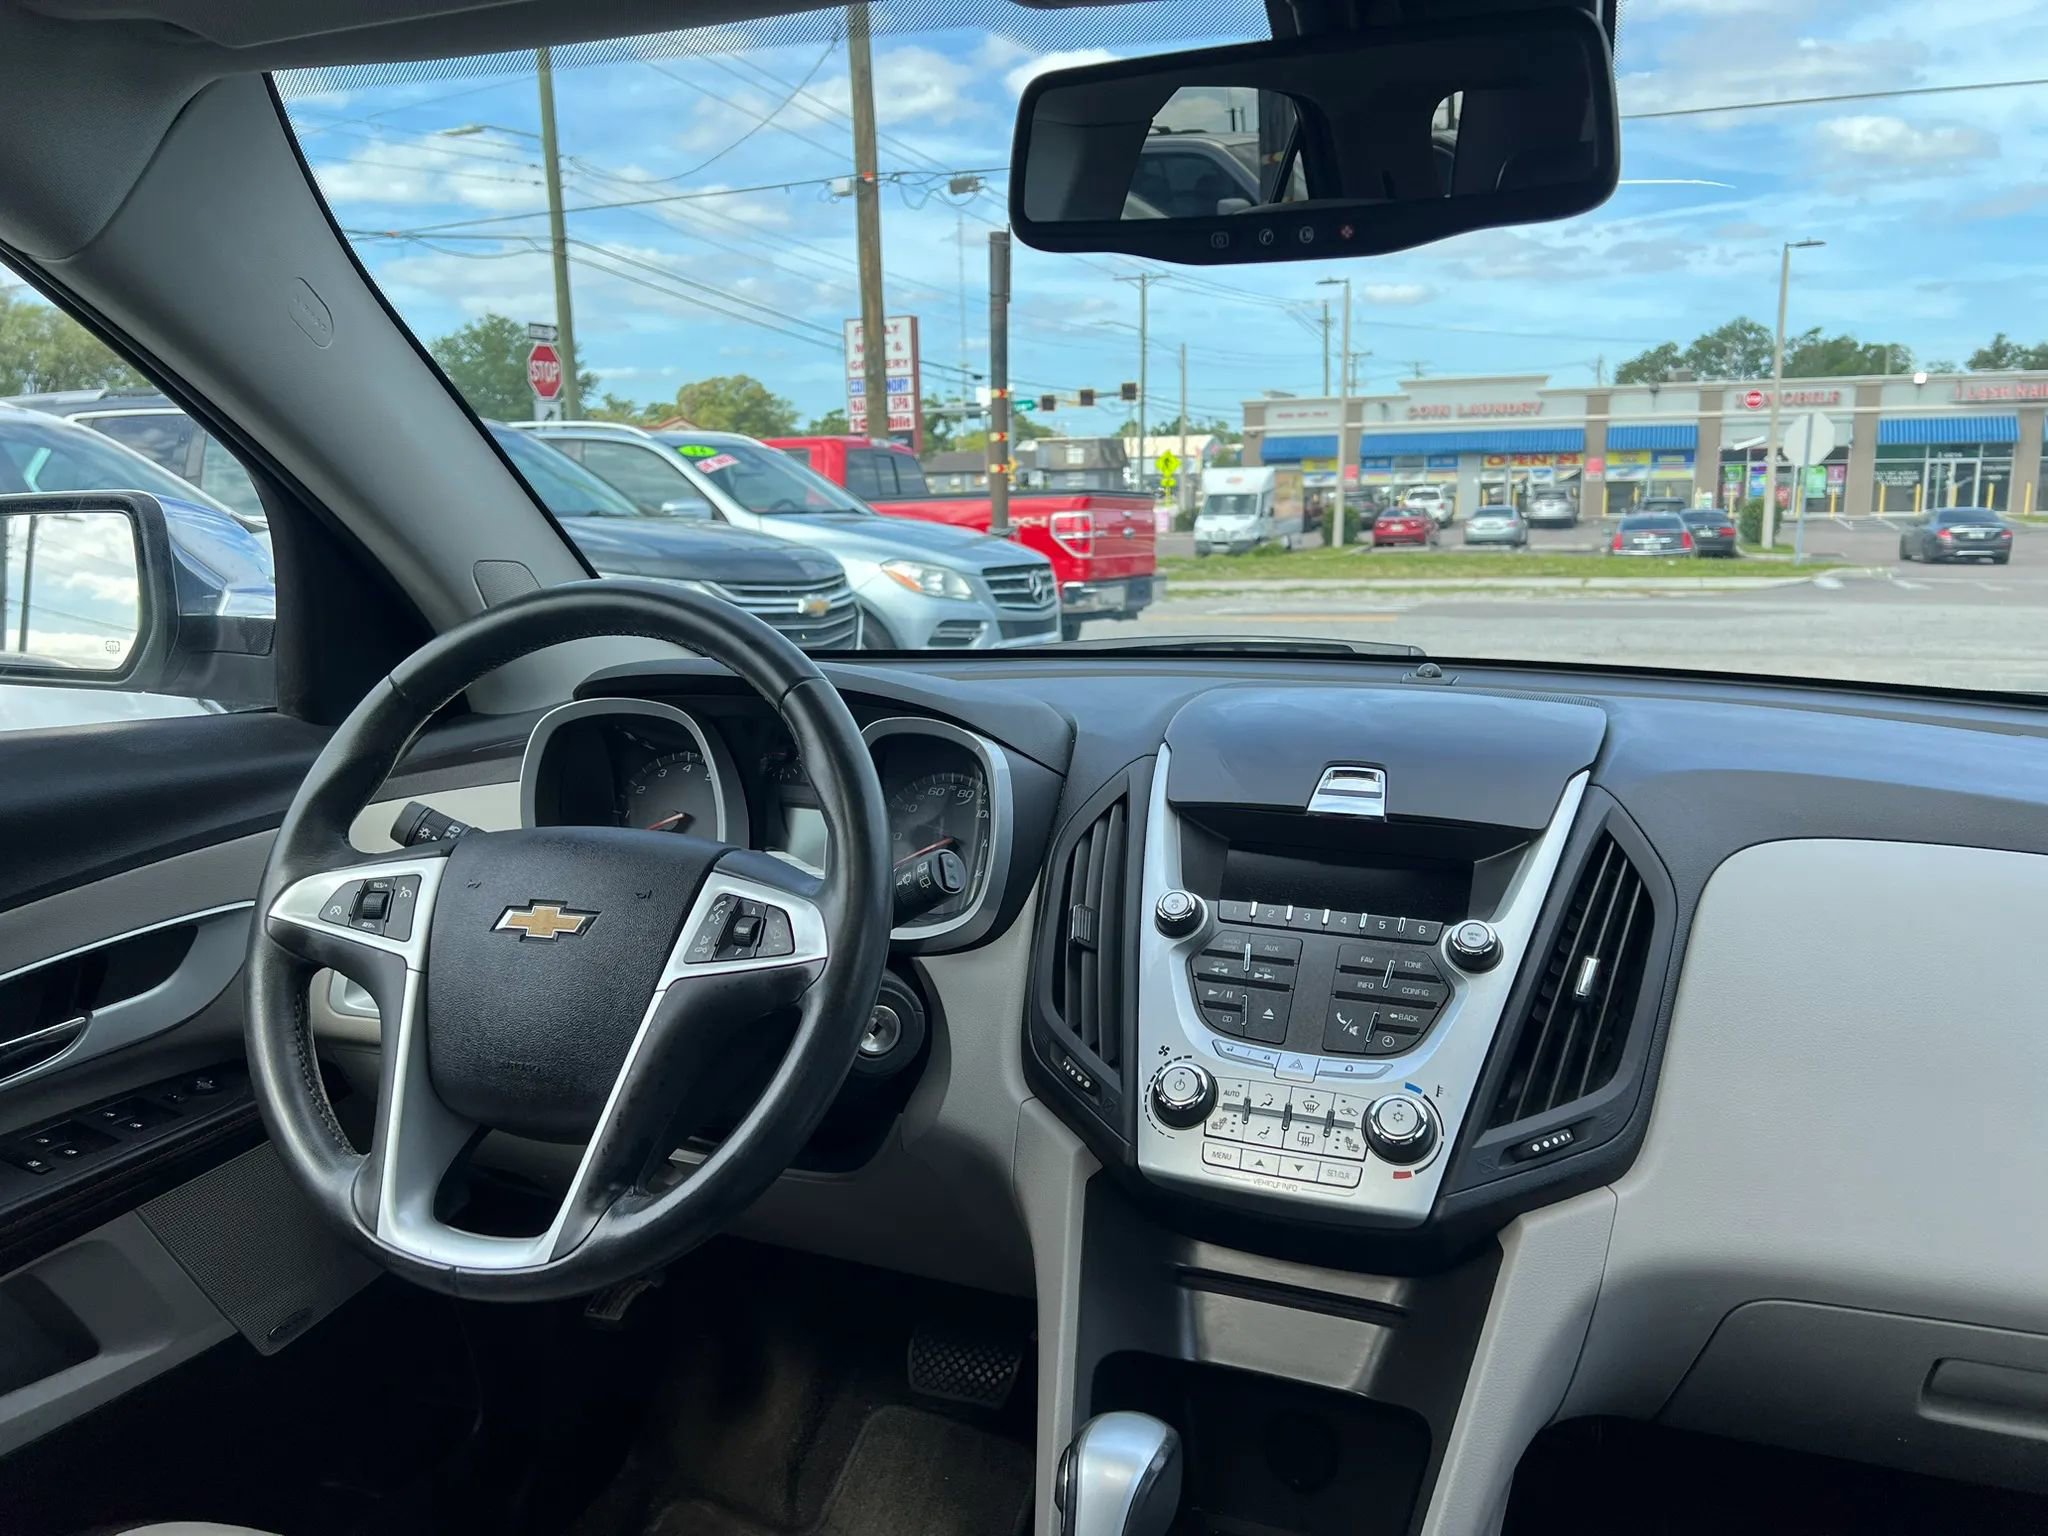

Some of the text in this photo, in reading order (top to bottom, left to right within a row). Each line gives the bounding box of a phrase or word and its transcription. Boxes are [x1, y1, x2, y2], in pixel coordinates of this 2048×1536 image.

[530, 360, 560, 382] STOP
[658, 768, 667, 777] 3
[683, 764, 692, 773] 4
[636, 785, 646, 794] 2
[927, 787, 946, 797] 60
[957, 789, 974, 798] 80
[1267, 909, 1276, 919] 2
[1303, 912, 1312, 922] 3
[1340, 916, 1348, 925] 4
[1378, 920, 1387, 930] 5
[1418, 925, 1427, 935] 6
[1264, 944, 1280, 952] AUX
[1404, 960, 1422, 969] TONE
[1357, 981, 1374, 989] INFO
[1401, 987, 1430, 996] CONFIG
[1398, 1013, 1419, 1022] BACK
[1223, 1089, 1240, 1098] AUTO
[1211, 1151, 1232, 1161] MENU
[1253, 1178, 1298, 1193] VEHICLE INFO
